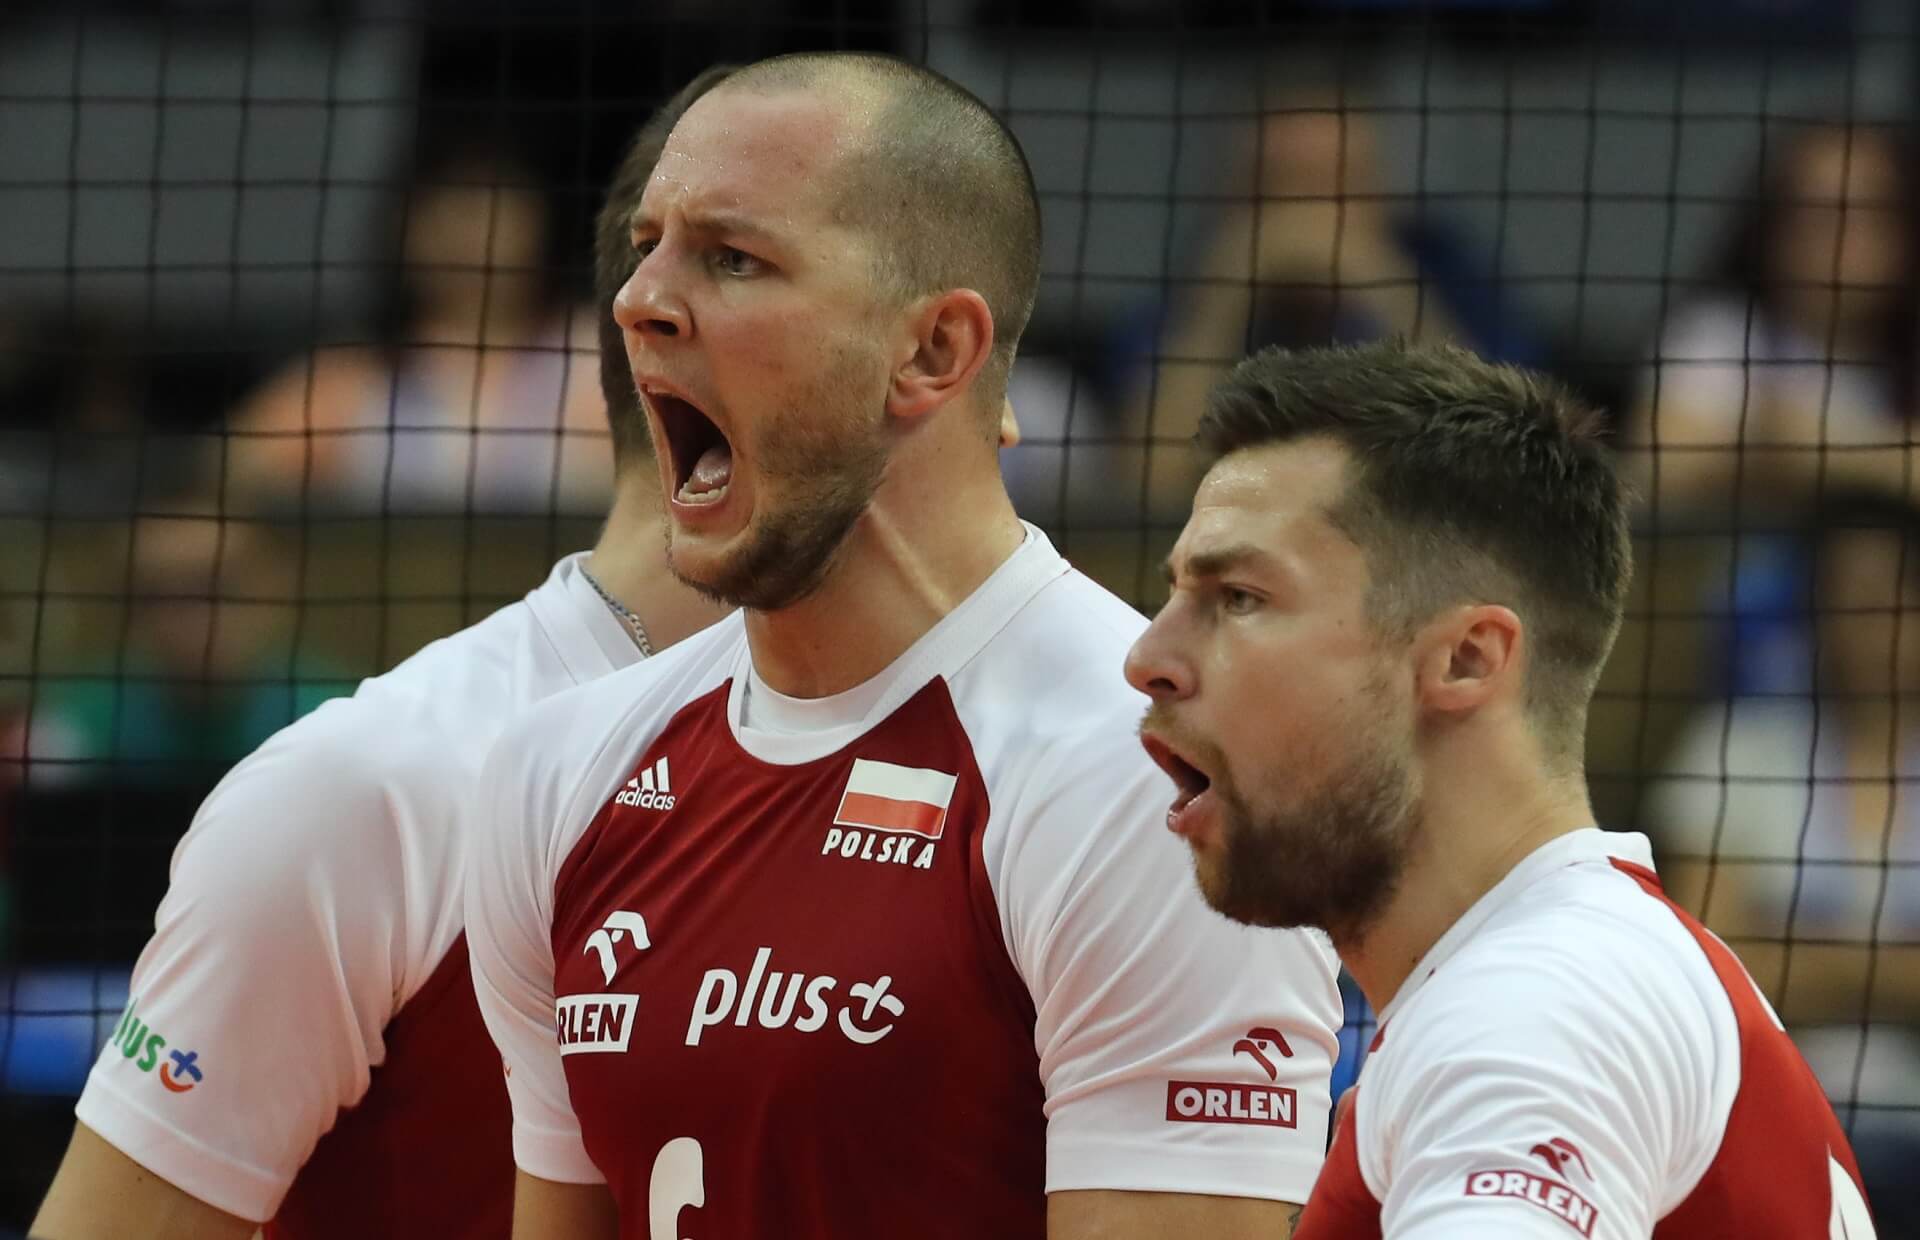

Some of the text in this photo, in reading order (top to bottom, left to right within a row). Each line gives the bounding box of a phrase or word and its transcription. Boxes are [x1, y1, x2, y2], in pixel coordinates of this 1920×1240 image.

[615, 787, 676, 810] adidas
[822, 828, 935, 869] POLSKA
[685, 947, 838, 1046] plus
[114, 997, 166, 1073] lus
[558, 1003, 627, 1046] RLEN
[1174, 1087, 1292, 1122] ORLEN
[1471, 1172, 1592, 1237] ORLEN
